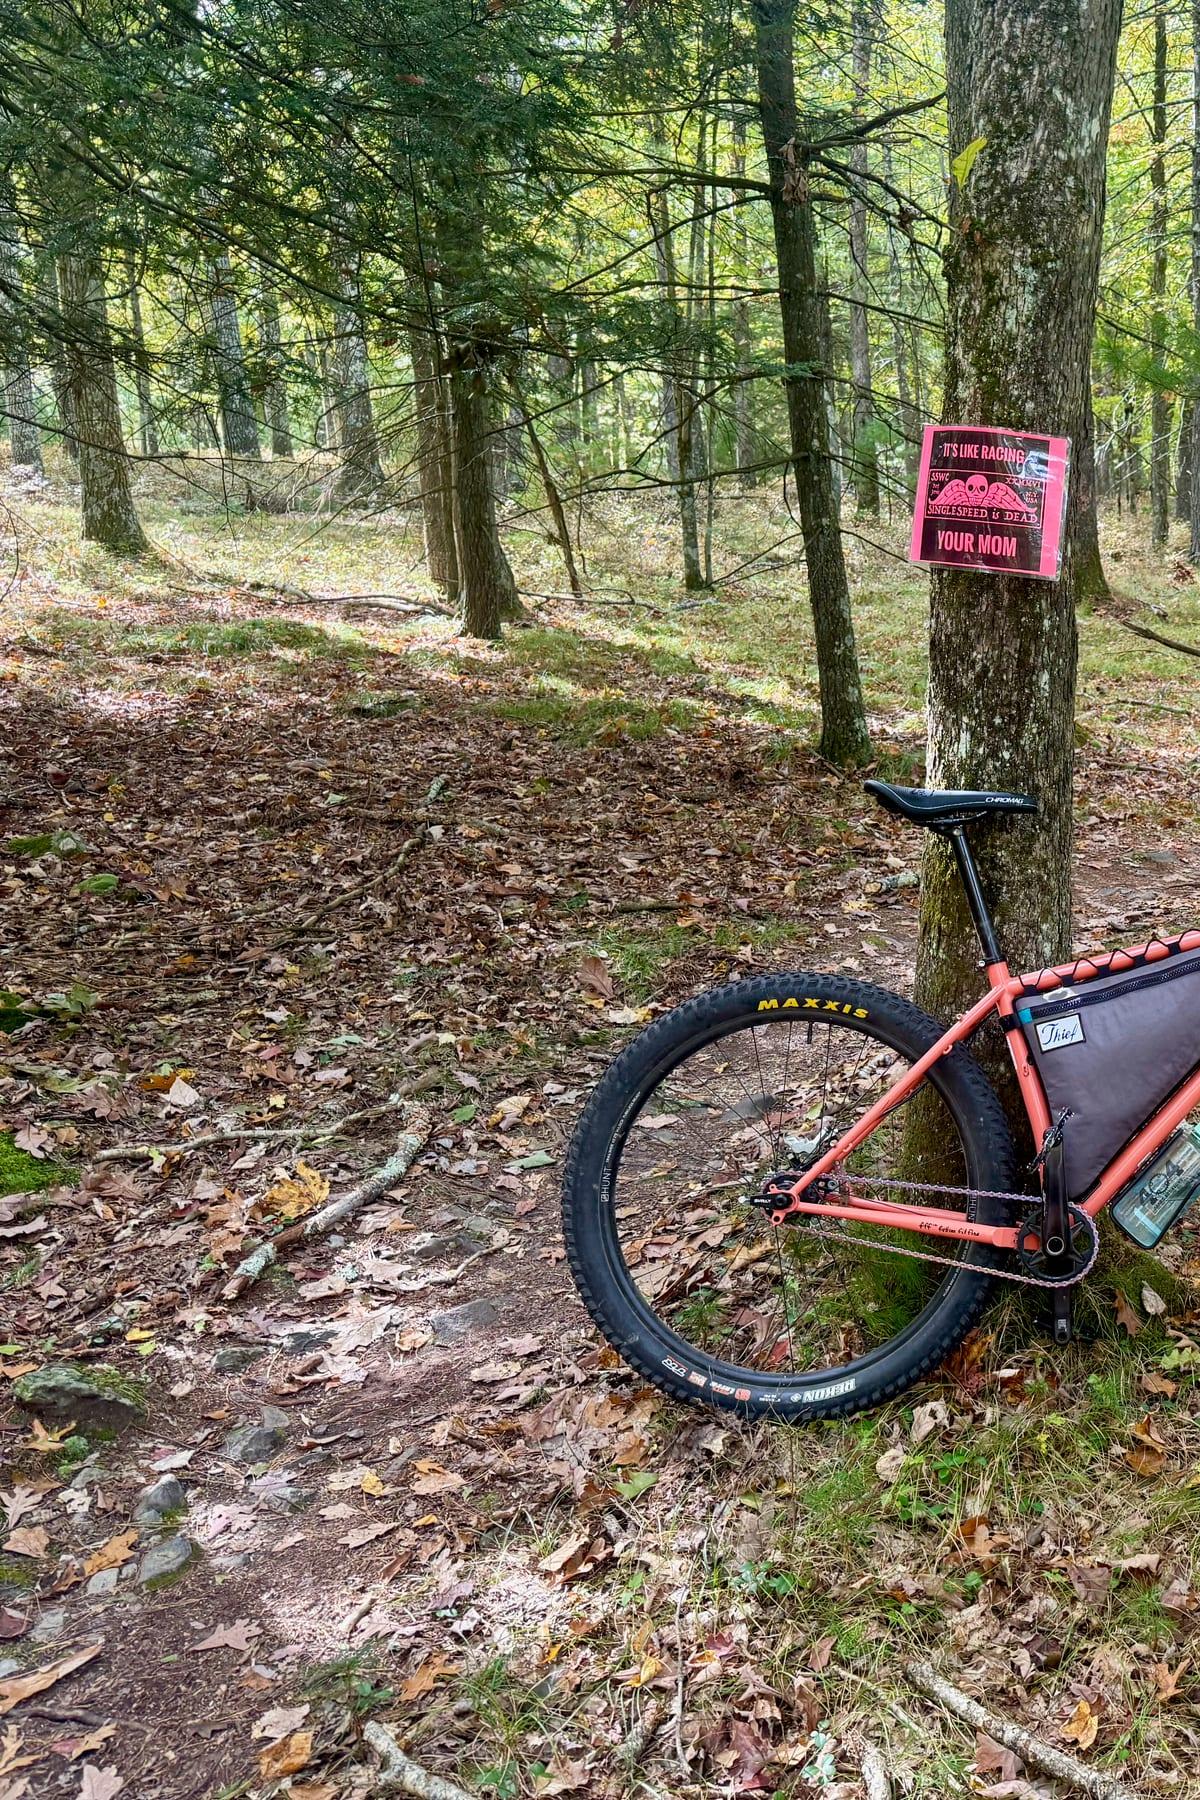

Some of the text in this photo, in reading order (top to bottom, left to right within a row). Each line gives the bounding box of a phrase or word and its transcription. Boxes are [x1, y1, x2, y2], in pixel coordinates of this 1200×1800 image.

[943, 443, 1025, 463] IT'S LIKE RACING
[931, 472, 949, 481] SSWC
[927, 504, 1038, 523] SINGLESPEED is DEAD
[937, 530, 1017, 557] YOUR MOM
[985, 796, 1024, 804] CHROMAG
[757, 997, 870, 1019] MAXXIS
[1041, 1023, 1079, 1046] Thief
[601, 1166, 612, 1196] HUNT
[801, 1378, 857, 1402] REKON
